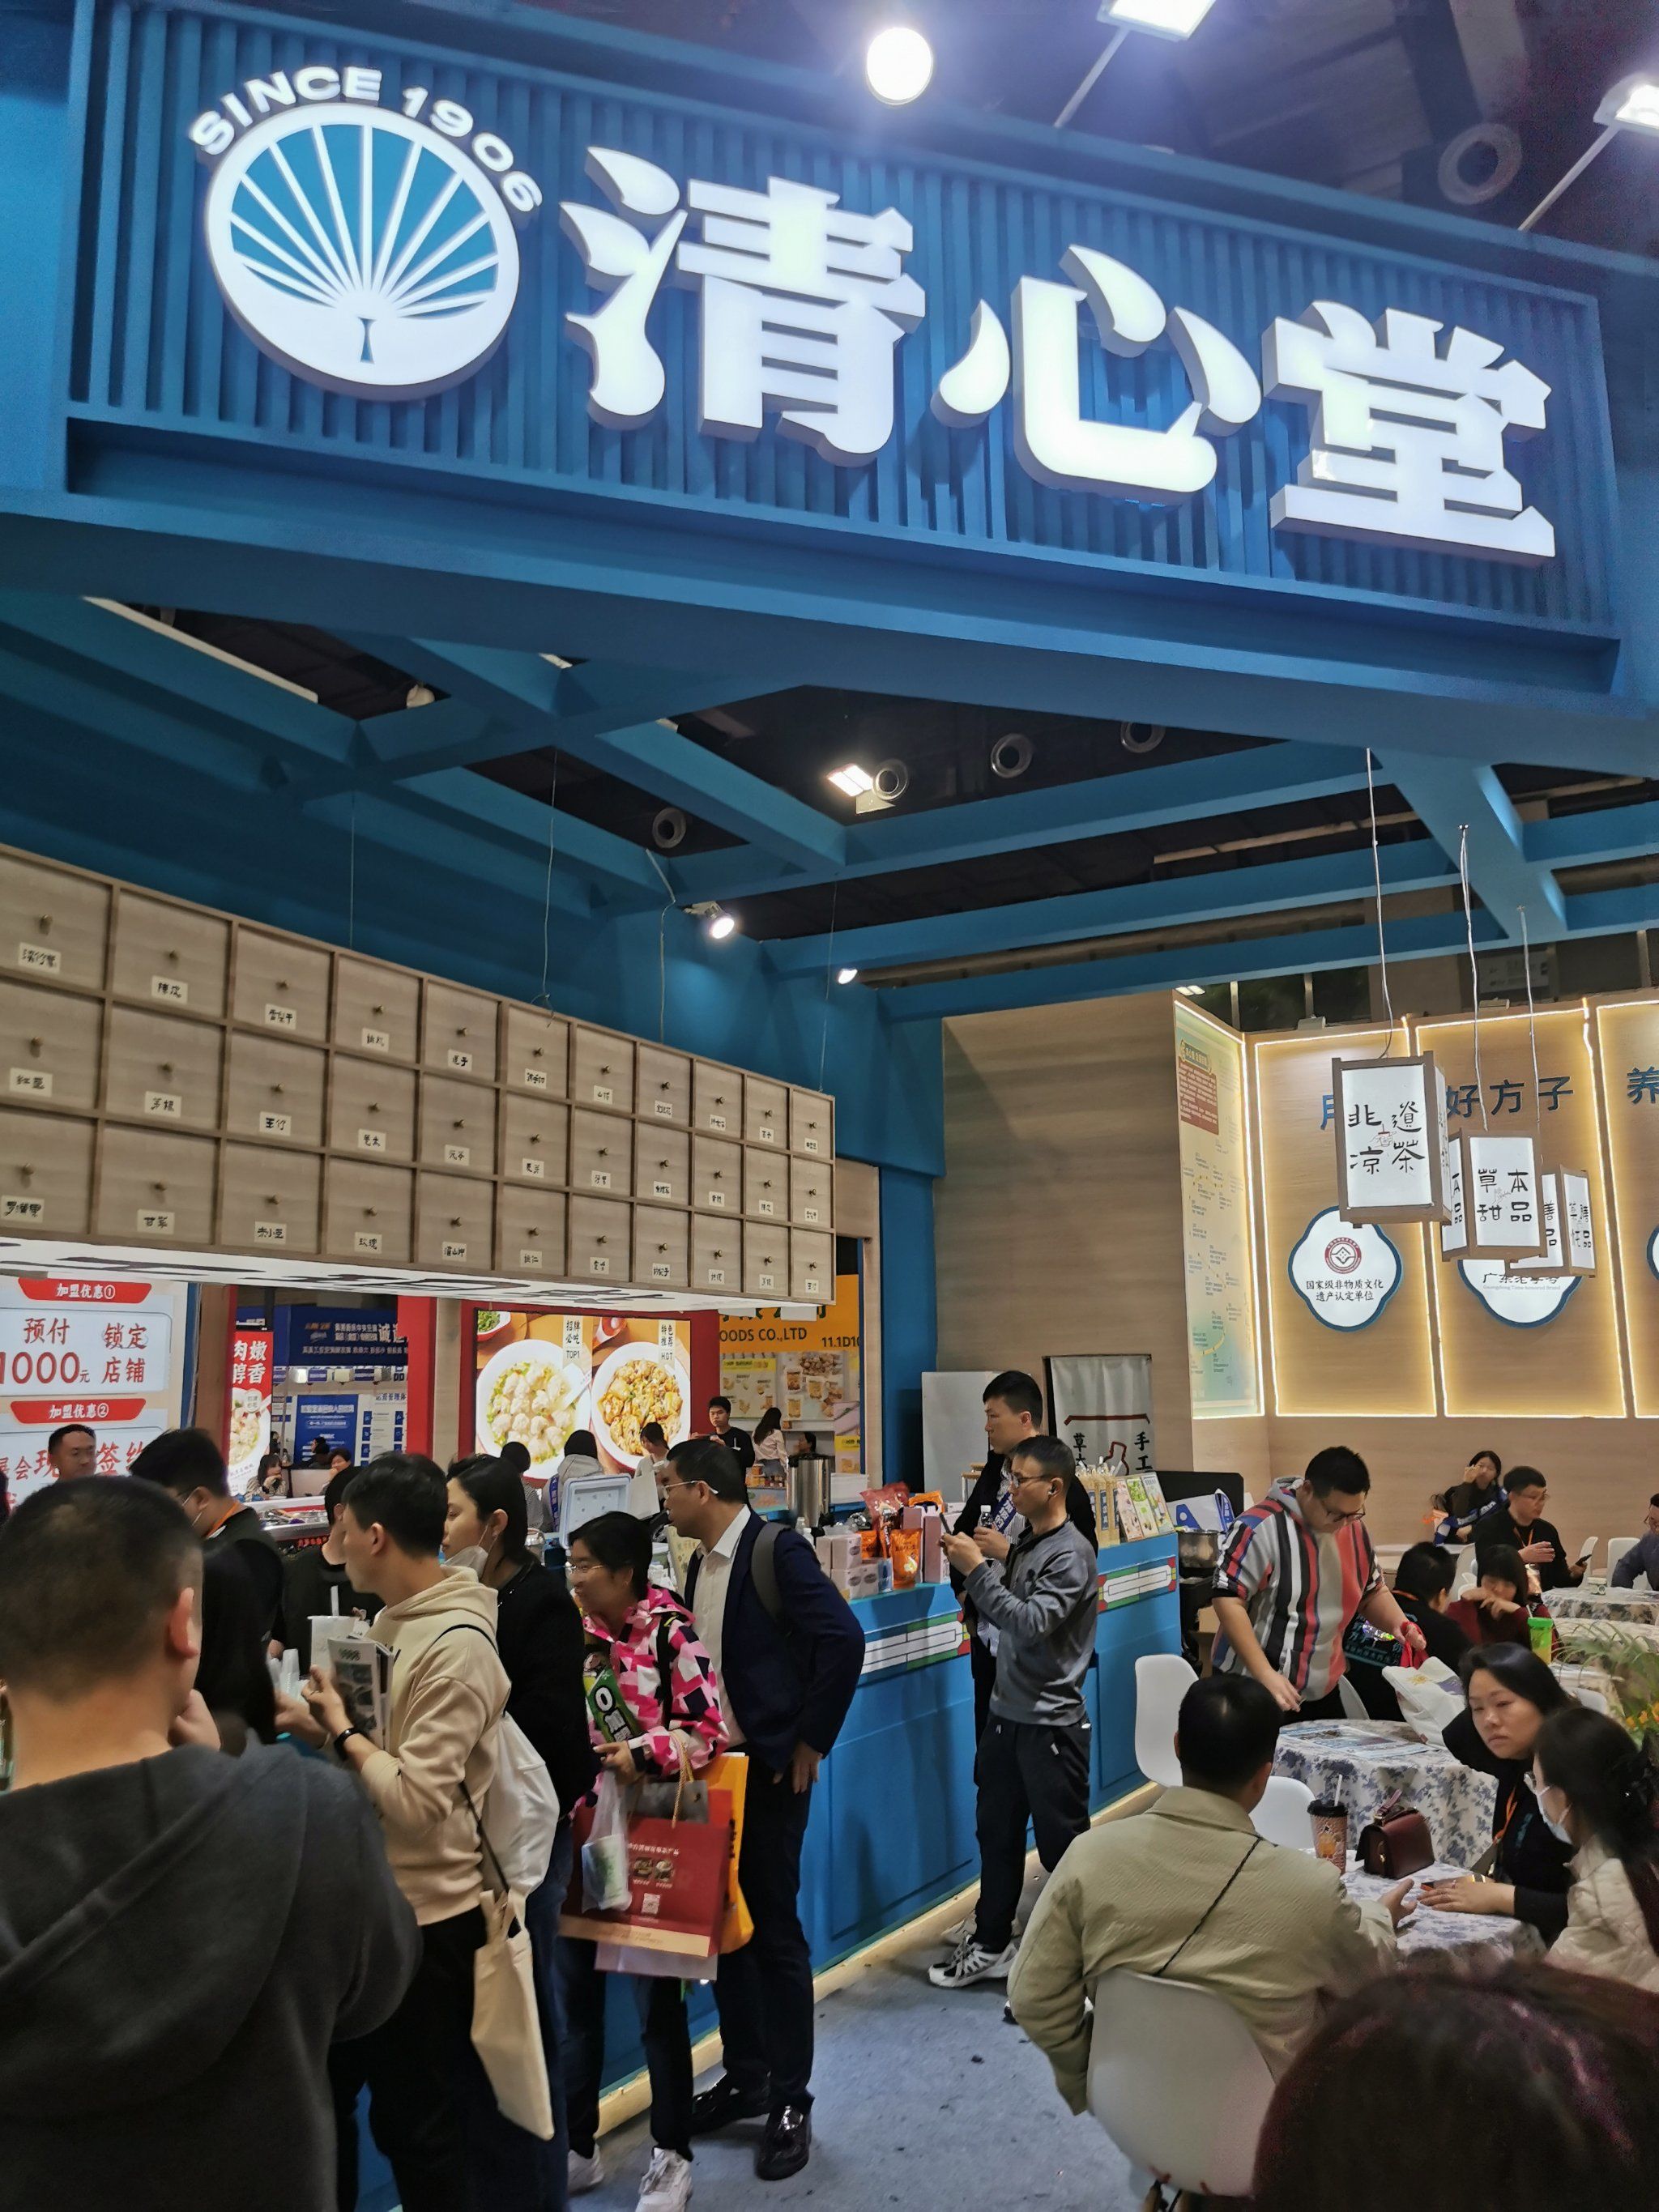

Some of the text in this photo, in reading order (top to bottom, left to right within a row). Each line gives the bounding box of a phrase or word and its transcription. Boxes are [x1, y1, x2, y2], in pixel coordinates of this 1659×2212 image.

[188, 66, 544, 212] SINCE 1906
[559, 146, 1555, 559] 清心堂
[1477, 1168, 1529, 1193] 草本
[1477, 1201, 1532, 1222] 甜品
[1306, 1279, 1384, 1290] 国家级非物质文化
[1316, 1290, 1375, 1302] 遗产认定单位
[23, 1317, 147, 1349] 预付 锁定
[101, 1356, 146, 1384] 店铺
